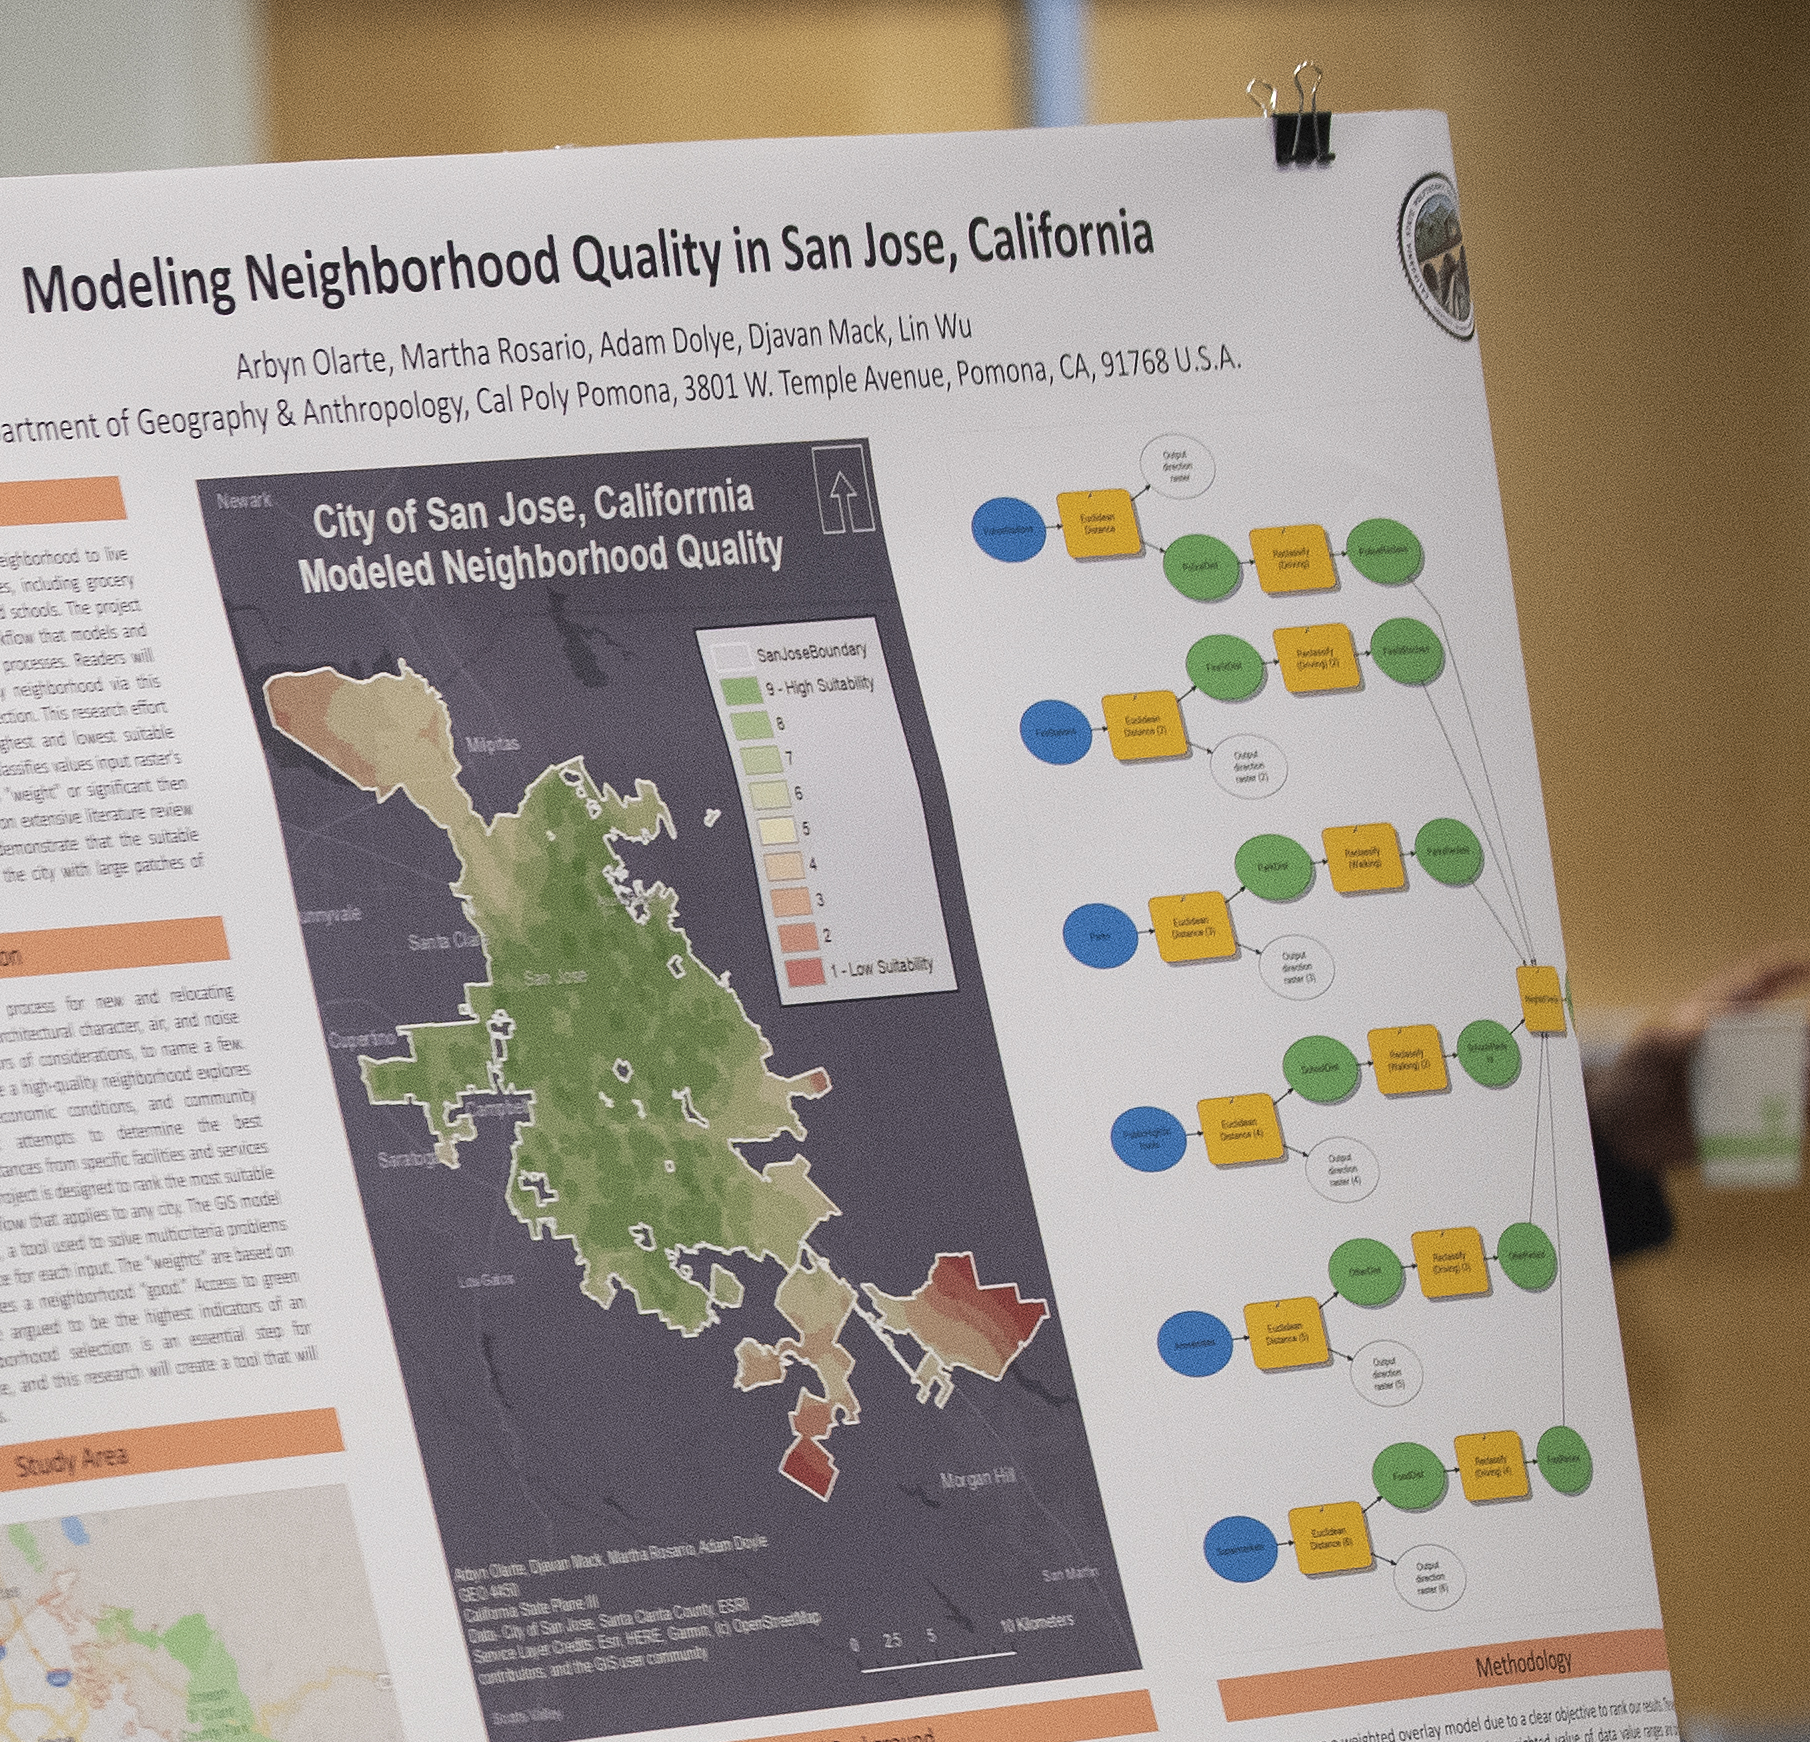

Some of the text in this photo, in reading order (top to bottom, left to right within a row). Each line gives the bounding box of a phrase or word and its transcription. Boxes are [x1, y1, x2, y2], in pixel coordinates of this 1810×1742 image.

[21, 207, 1154, 317] Modeling Neighborhood Quality in San Jose, California
[236, 312, 972, 385] Arbyn Olarte, Martha Rosario, Adam Dolye, Djavan Mack, Lin Wu
[106, 406, 130, 438] of
[137, 400, 269, 441] Geography
[276, 398, 297, 428] &
[303, 390, 470, 427] Anthropology,
[475, 384, 514, 415] Cal
[519, 381, 570, 416] Poly
[576, 380, 678, 408] Pomona,
[683, 372, 739, 402] 3801
[743, 370, 773, 398] W.
[777, 365, 857, 401] Temple
[864, 364, 952, 392] Avenue,
[955, 359, 1054, 386] Pomona,
[1058, 352, 1097, 383] CA,
[1100, 347, 1170, 378] 91768
[1173, 343, 1241, 374] U.S.A.
[313, 503, 375, 546] City
[386, 498, 417, 535] of
[426, 496, 489, 532] San
[499, 491, 587, 528] Jose,
[298, 530, 783, 594] Modeled Neighborhood Quality
[756, 643, 867, 663] SanJoseBoundary
[766, 682, 775, 697] 9
[784, 680, 814, 699] High
[816, 675, 875, 694] Suitability
[14, 1447, 129, 1479] Study Area
[1475, 1648, 1572, 1678] Methodology
